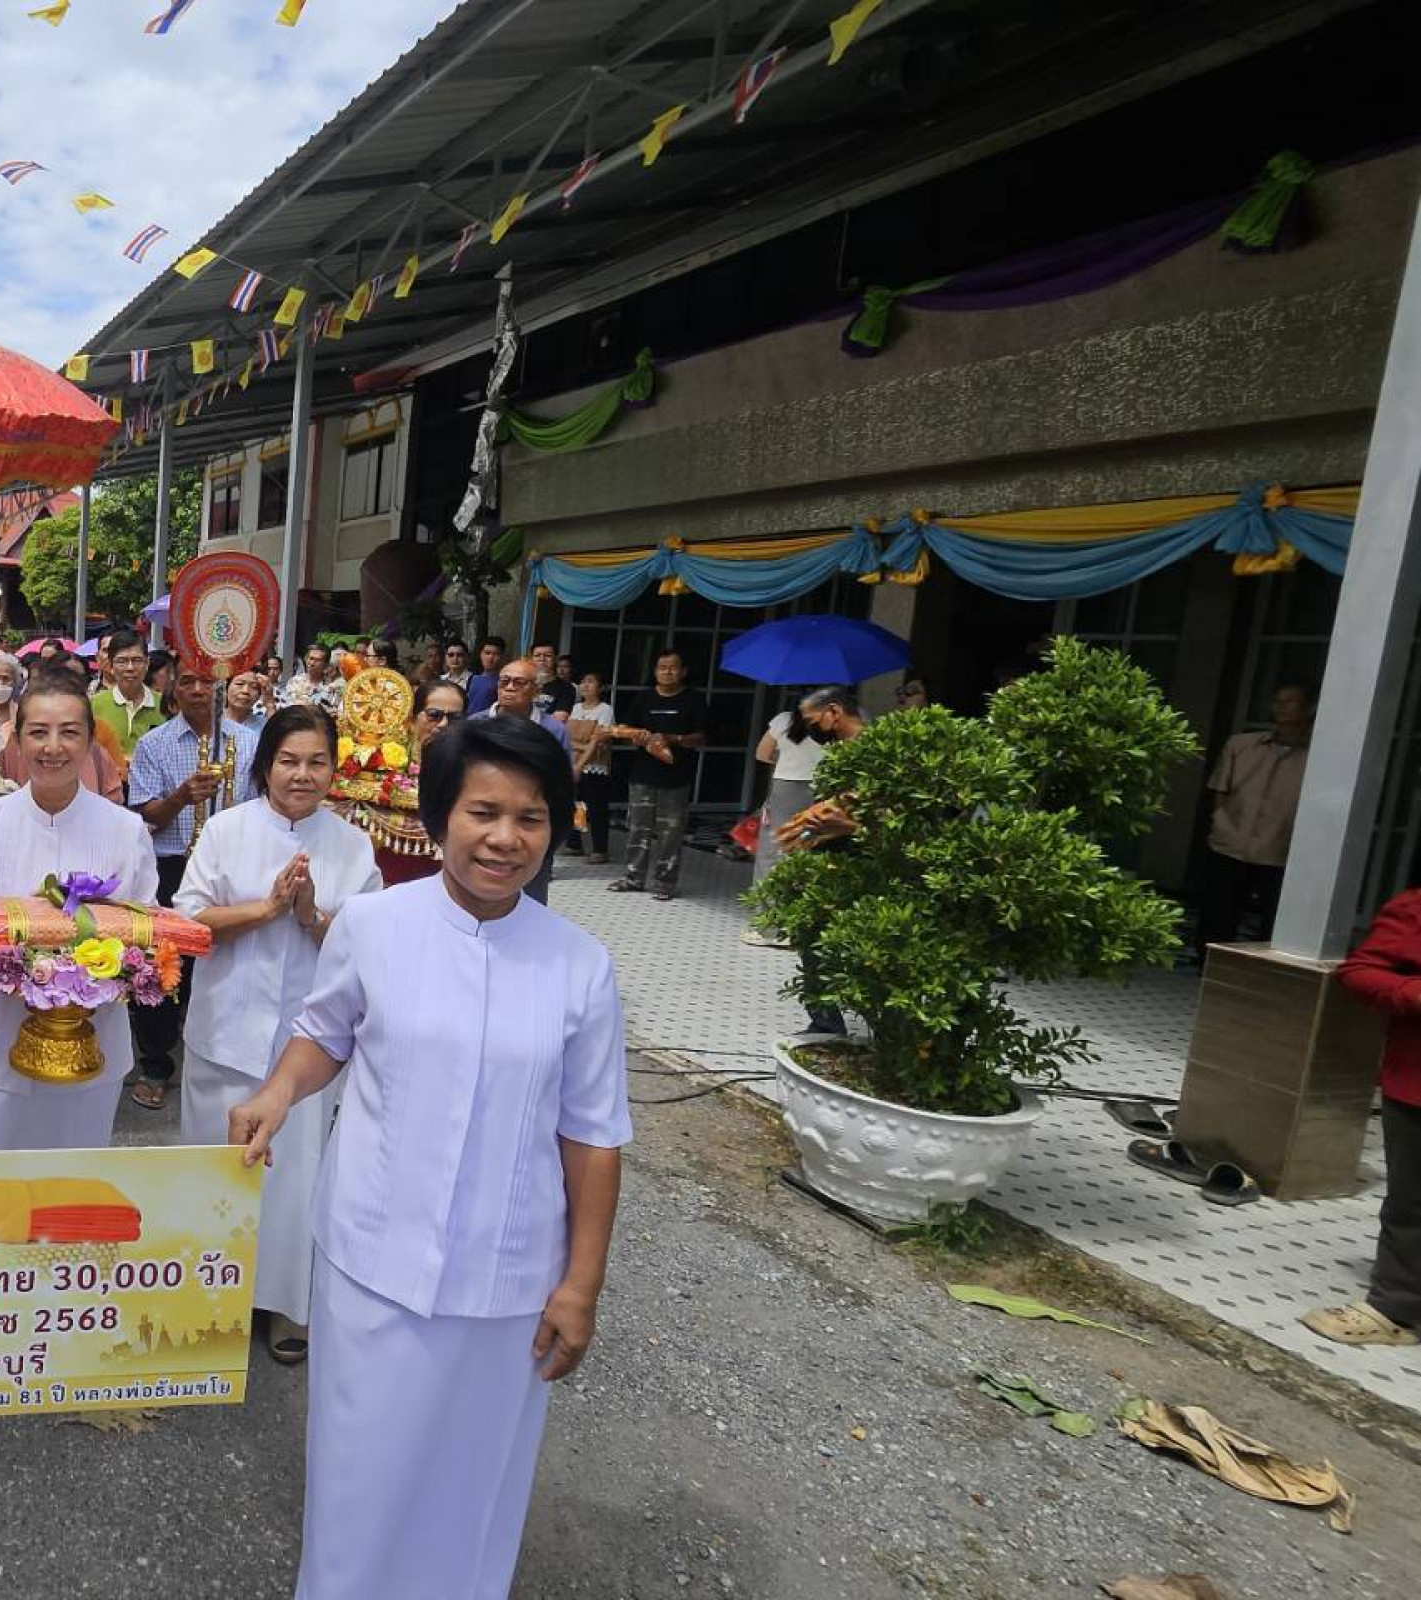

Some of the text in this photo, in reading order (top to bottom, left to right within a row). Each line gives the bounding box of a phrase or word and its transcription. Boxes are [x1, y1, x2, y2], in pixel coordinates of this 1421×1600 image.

[52, 1261, 183, 1296] 30,000
[197, 1253, 241, 1287] วัด
[33, 1306, 119, 1333] 2568
[19, 1389, 42, 1405] 81
[51, 1384, 66, 1403] ปี
[74, 1376, 231, 1401] หลวงพ่อธัมมชโย
